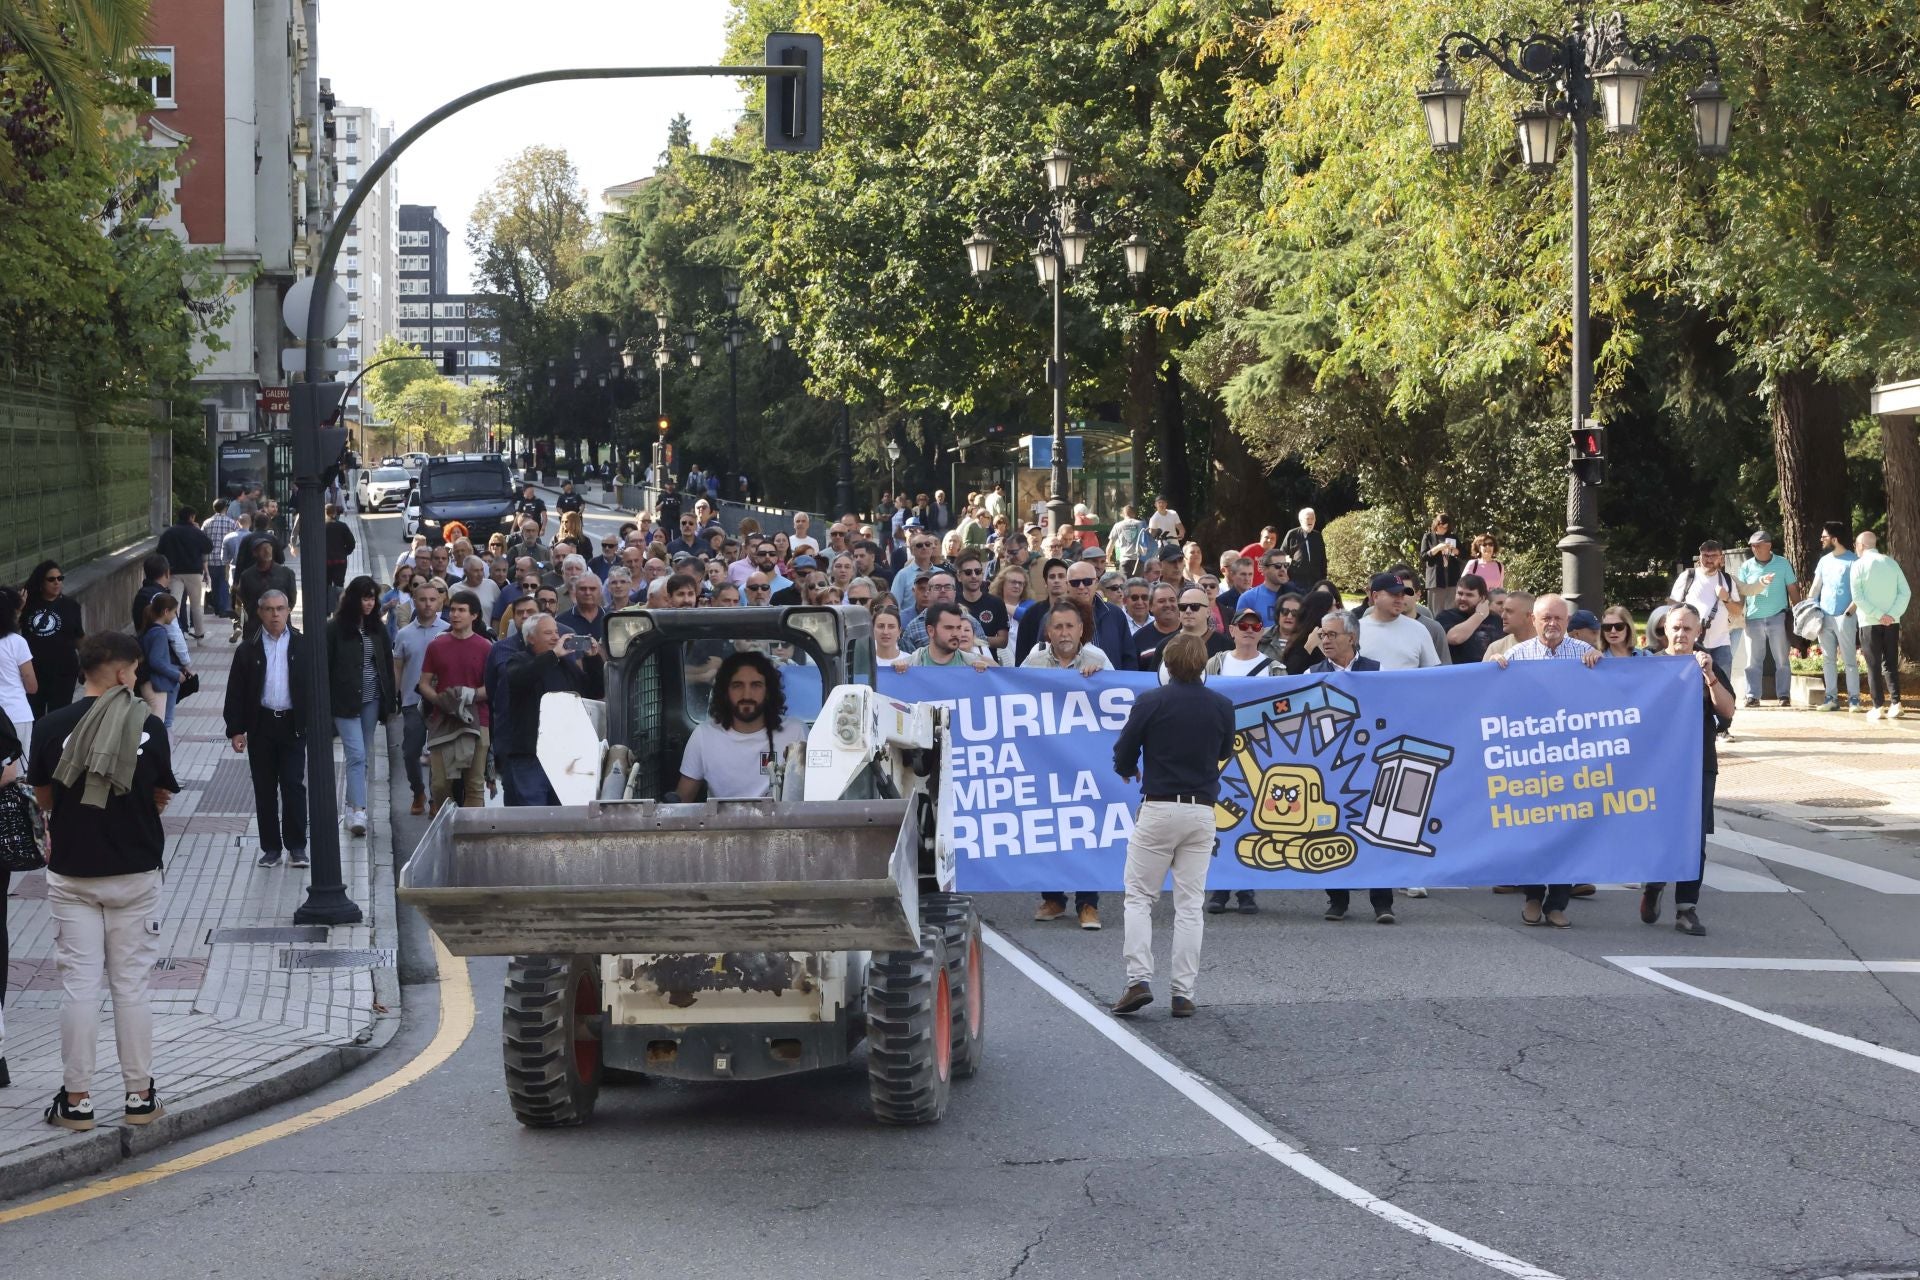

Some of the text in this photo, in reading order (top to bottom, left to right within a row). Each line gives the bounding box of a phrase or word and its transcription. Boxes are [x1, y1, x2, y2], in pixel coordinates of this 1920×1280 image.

[1480, 706, 1641, 741] Plataforma
[1483, 737, 1631, 770] Ciudadana
[953, 770, 1102, 812] MPE LA
[1487, 762, 1614, 799] Peaje del
[1490, 787, 1657, 829] Huerna NO!
[954, 802, 1136, 860] RRERA
